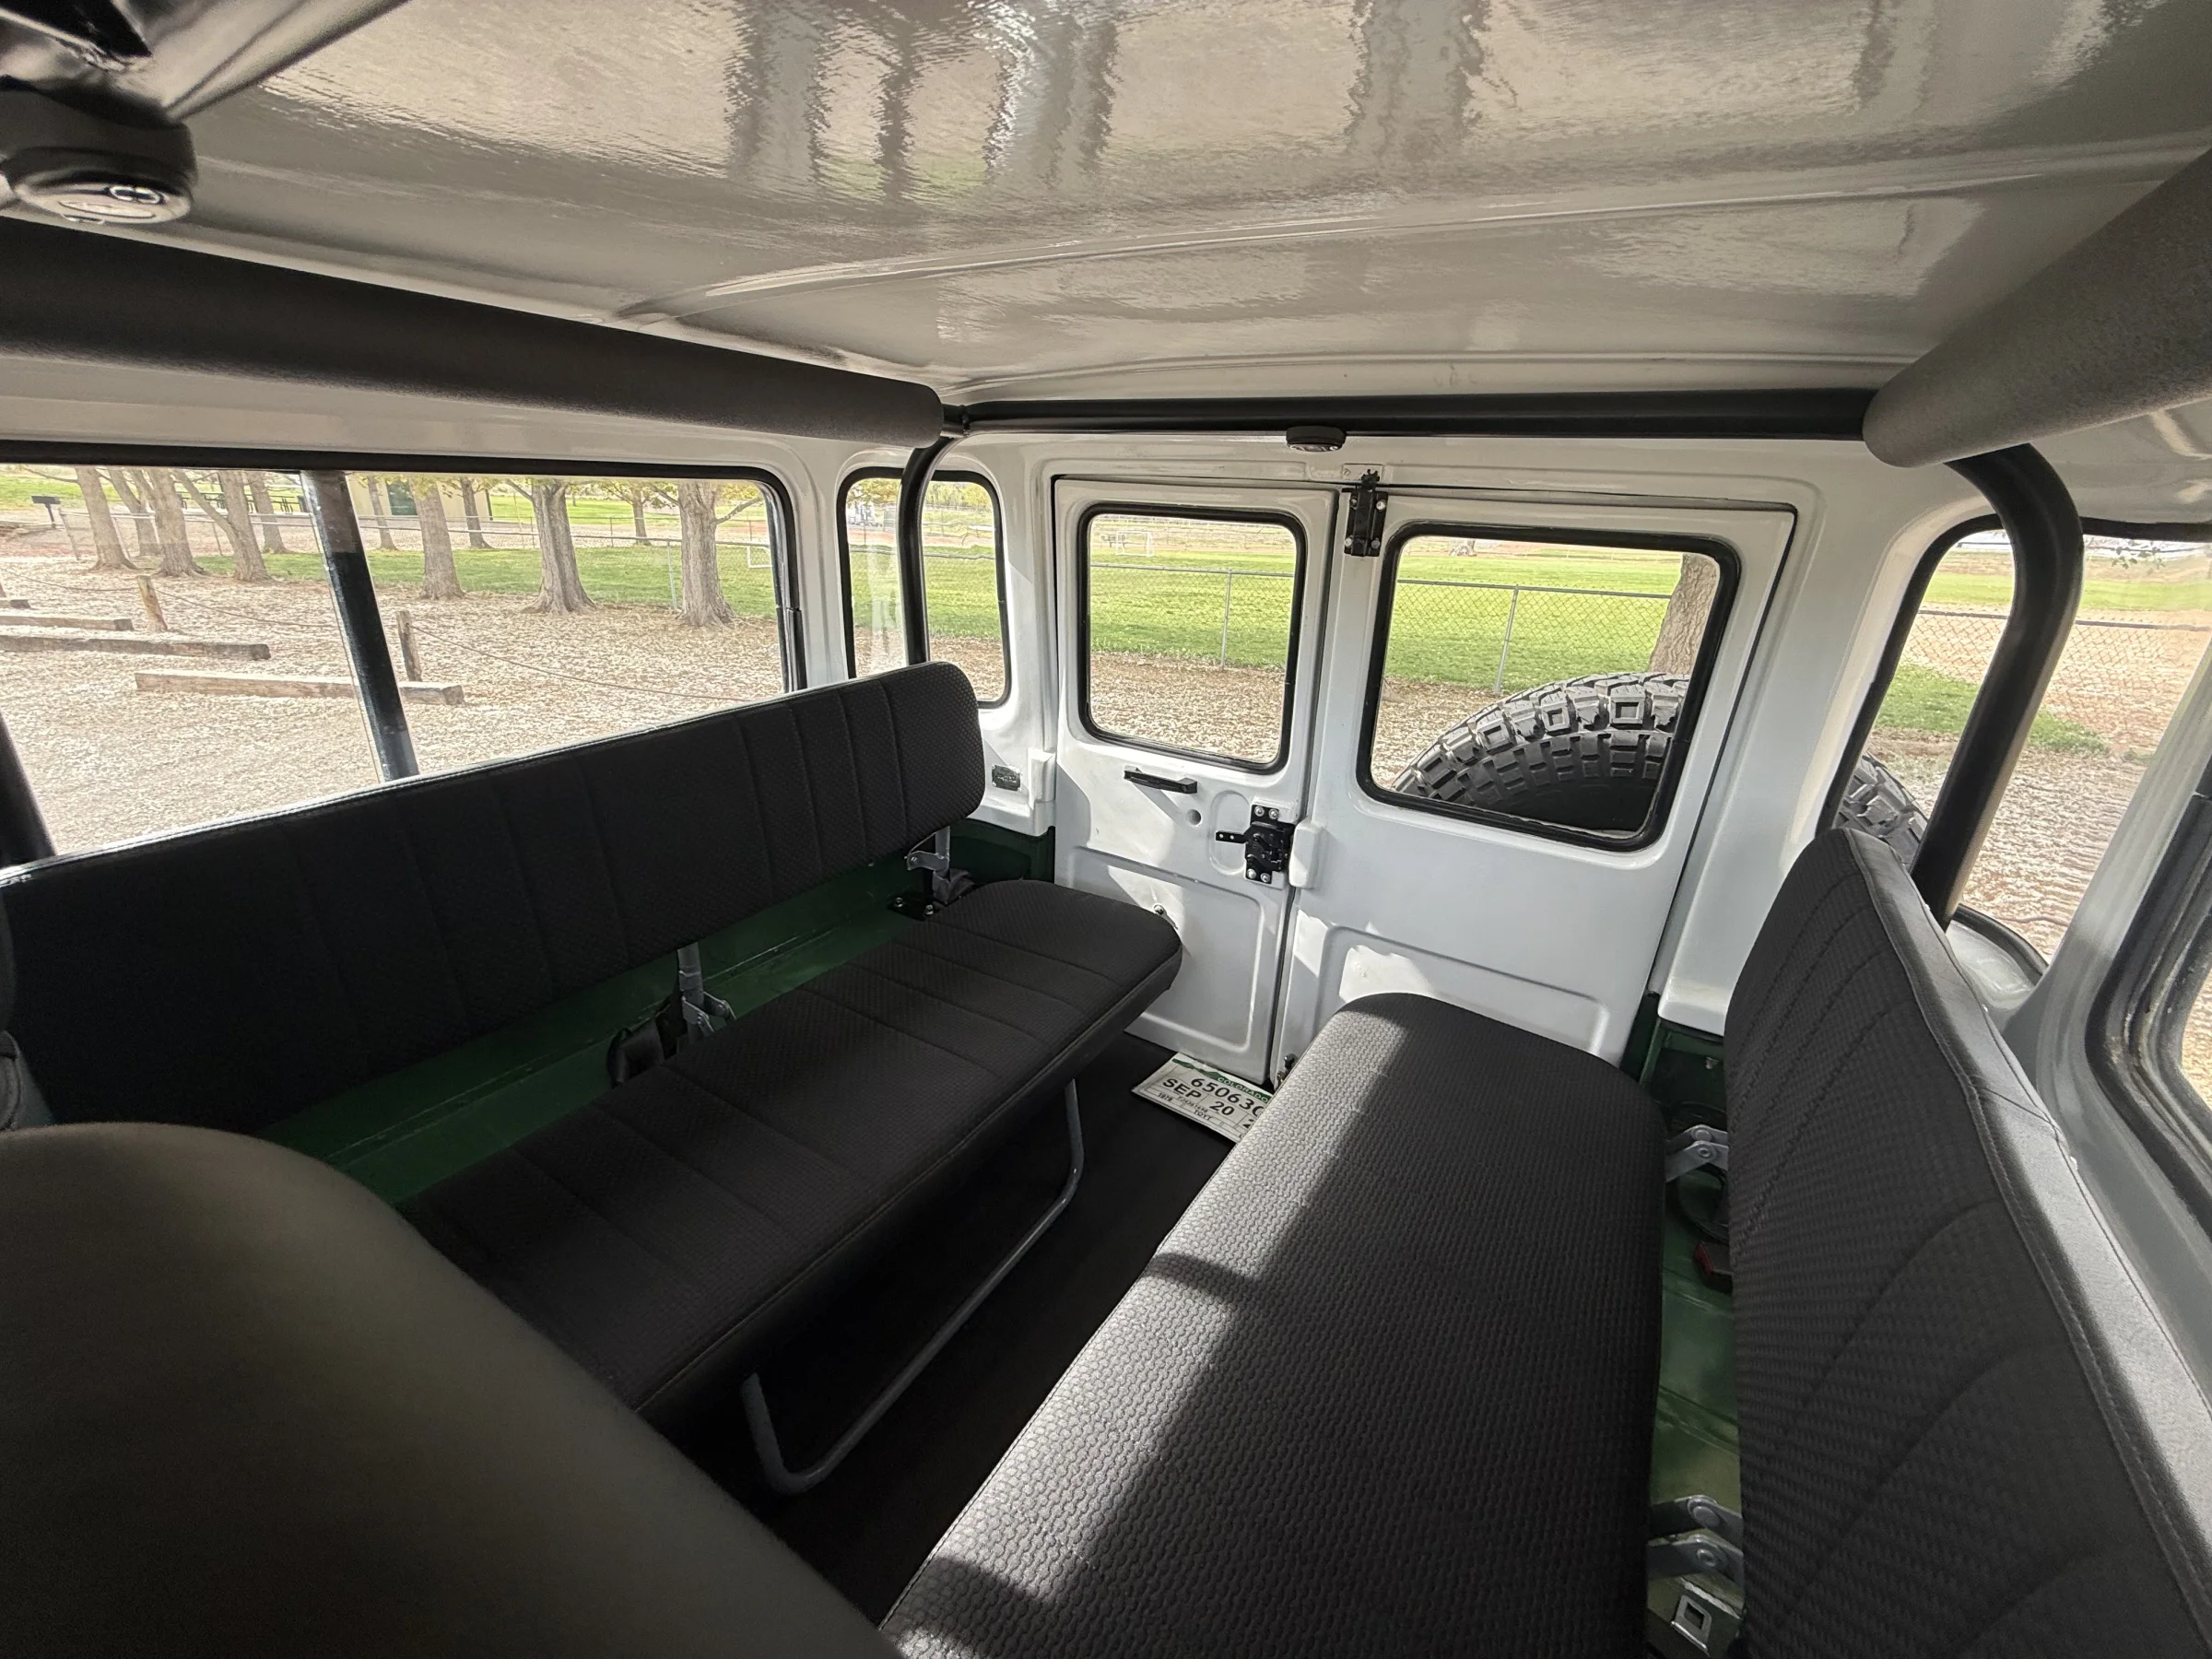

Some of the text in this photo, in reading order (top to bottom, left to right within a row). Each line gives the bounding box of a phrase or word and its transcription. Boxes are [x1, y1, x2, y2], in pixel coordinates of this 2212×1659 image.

[1162, 1078, 1202, 1100] SEP
[1209, 1100, 1235, 1116] 20
[1217, 1077, 1269, 1102] COLORADO
[1194, 1110, 1214, 1121] TOYT
